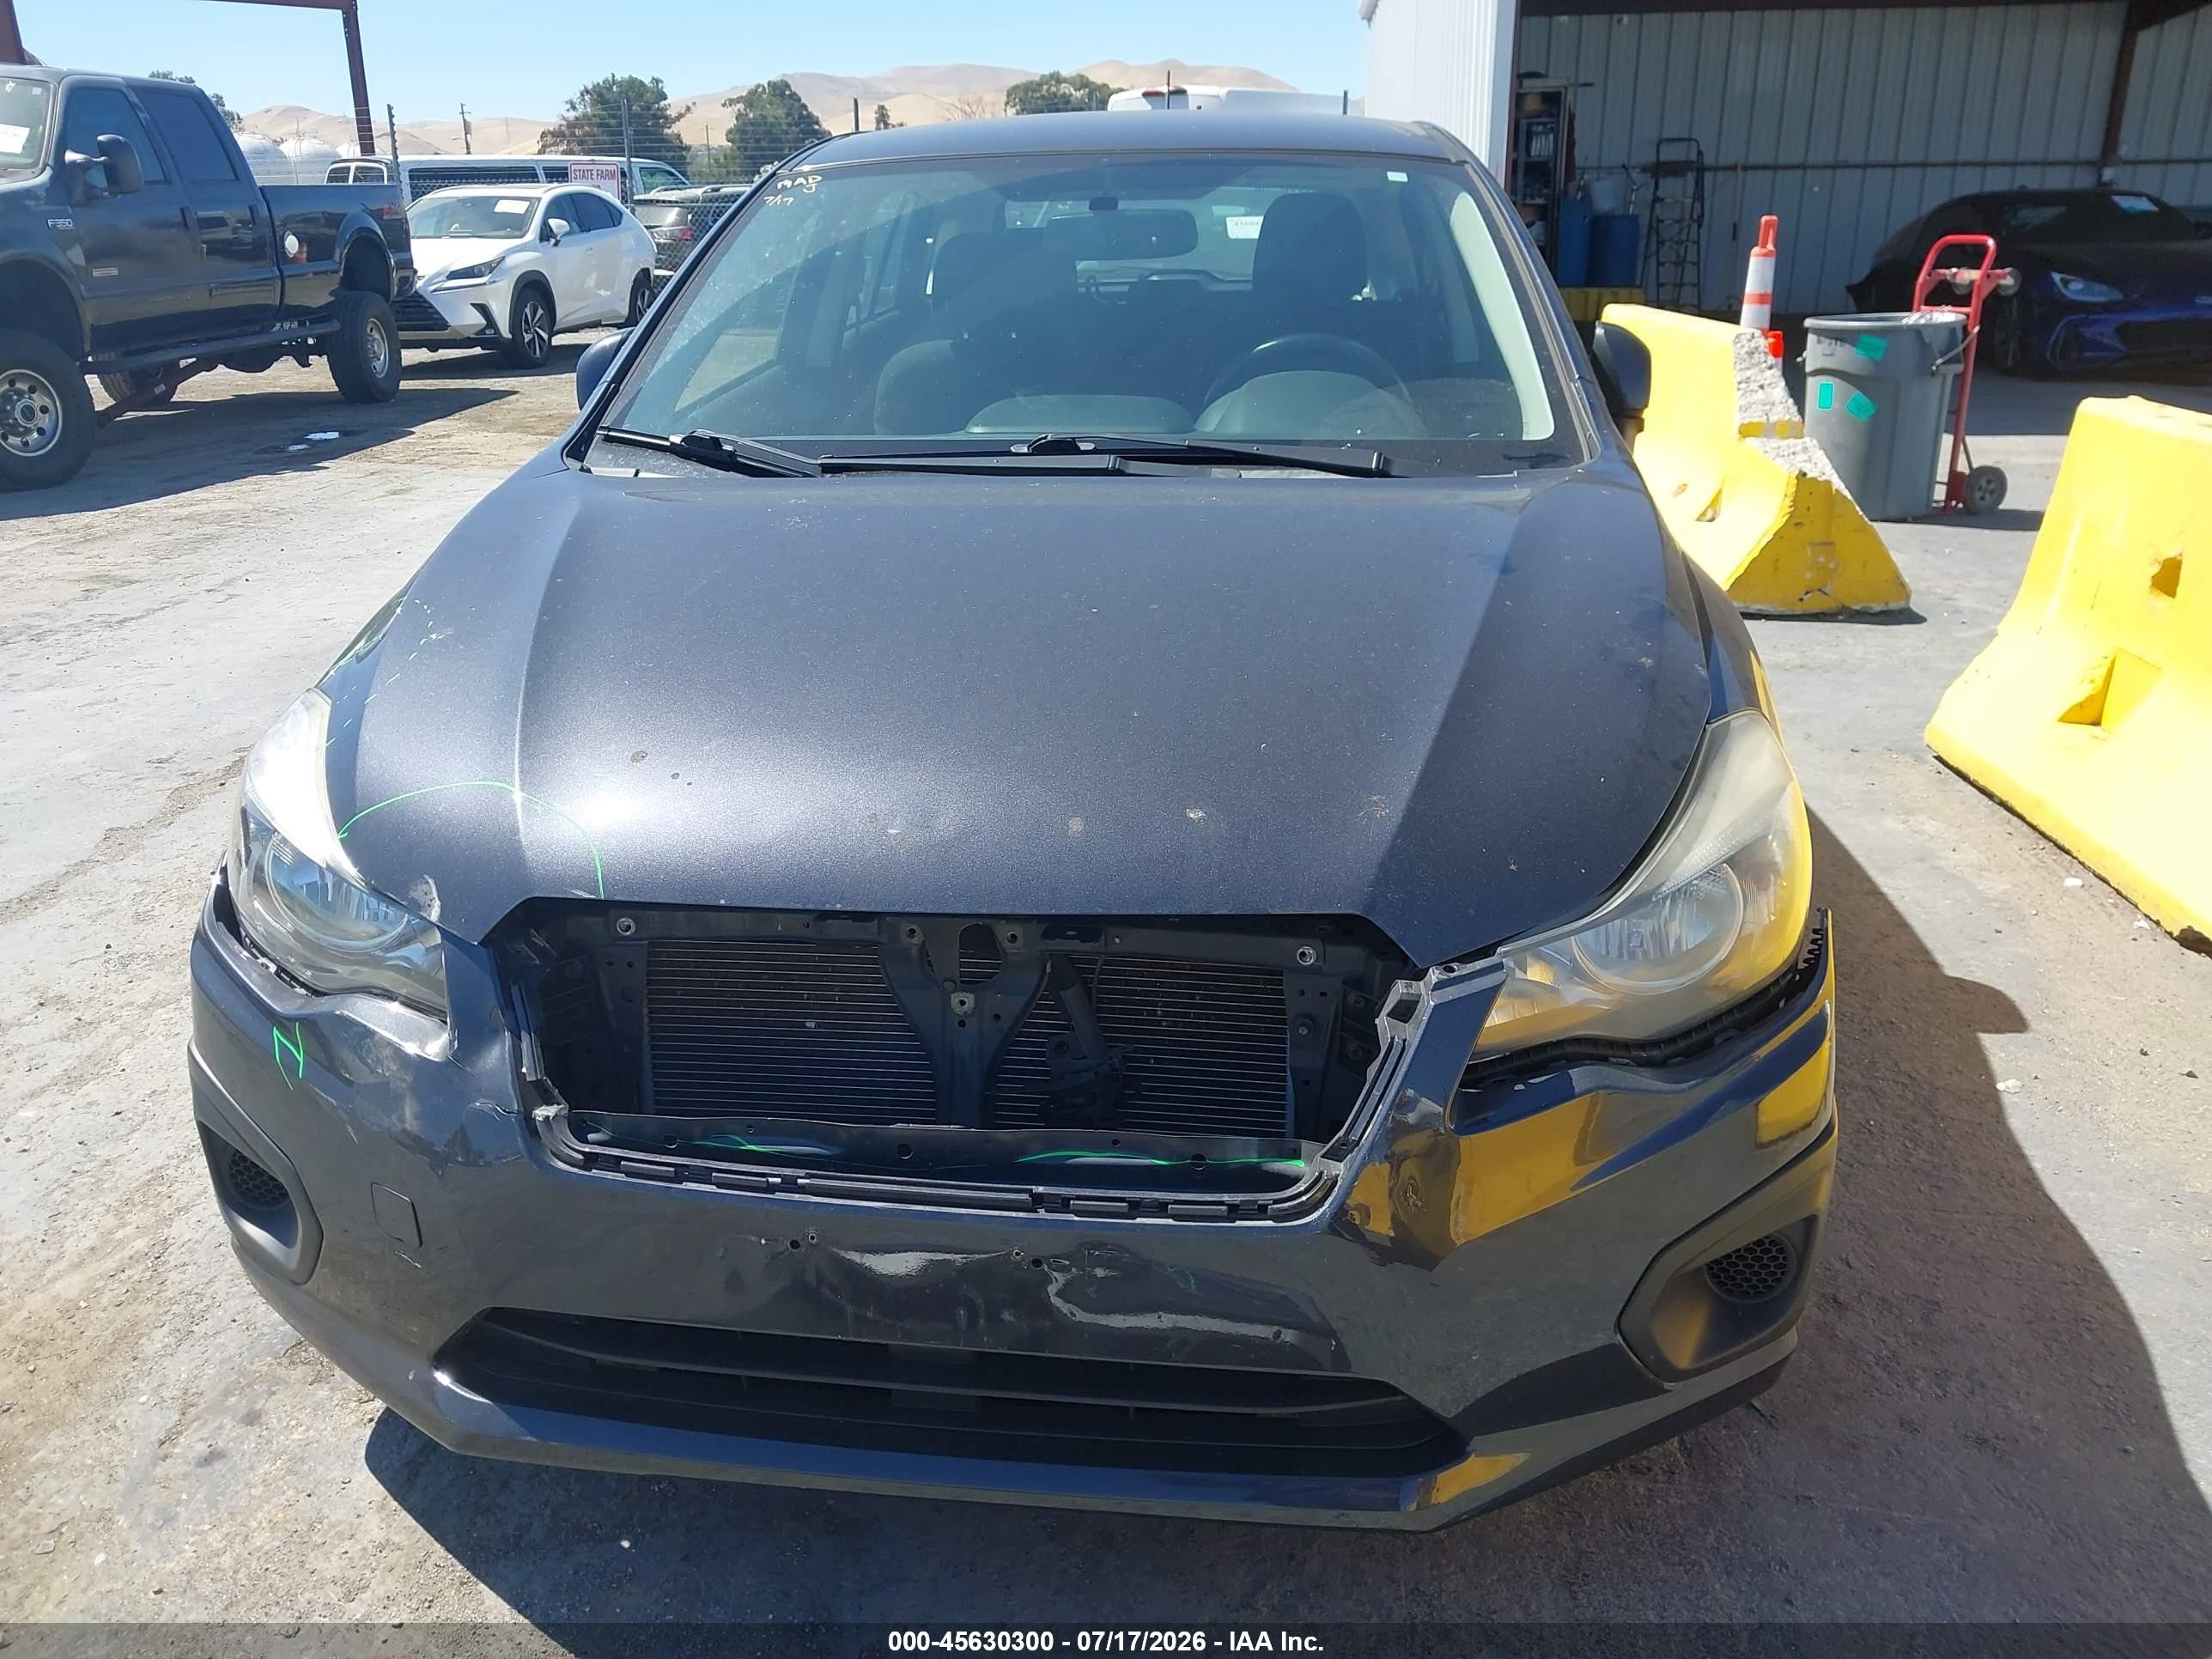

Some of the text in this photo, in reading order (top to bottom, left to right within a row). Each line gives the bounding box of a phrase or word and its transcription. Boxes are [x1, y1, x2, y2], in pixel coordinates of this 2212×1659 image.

[573, 169, 617, 180] STATE FARM
[763, 194, 794, 206] 7/17
